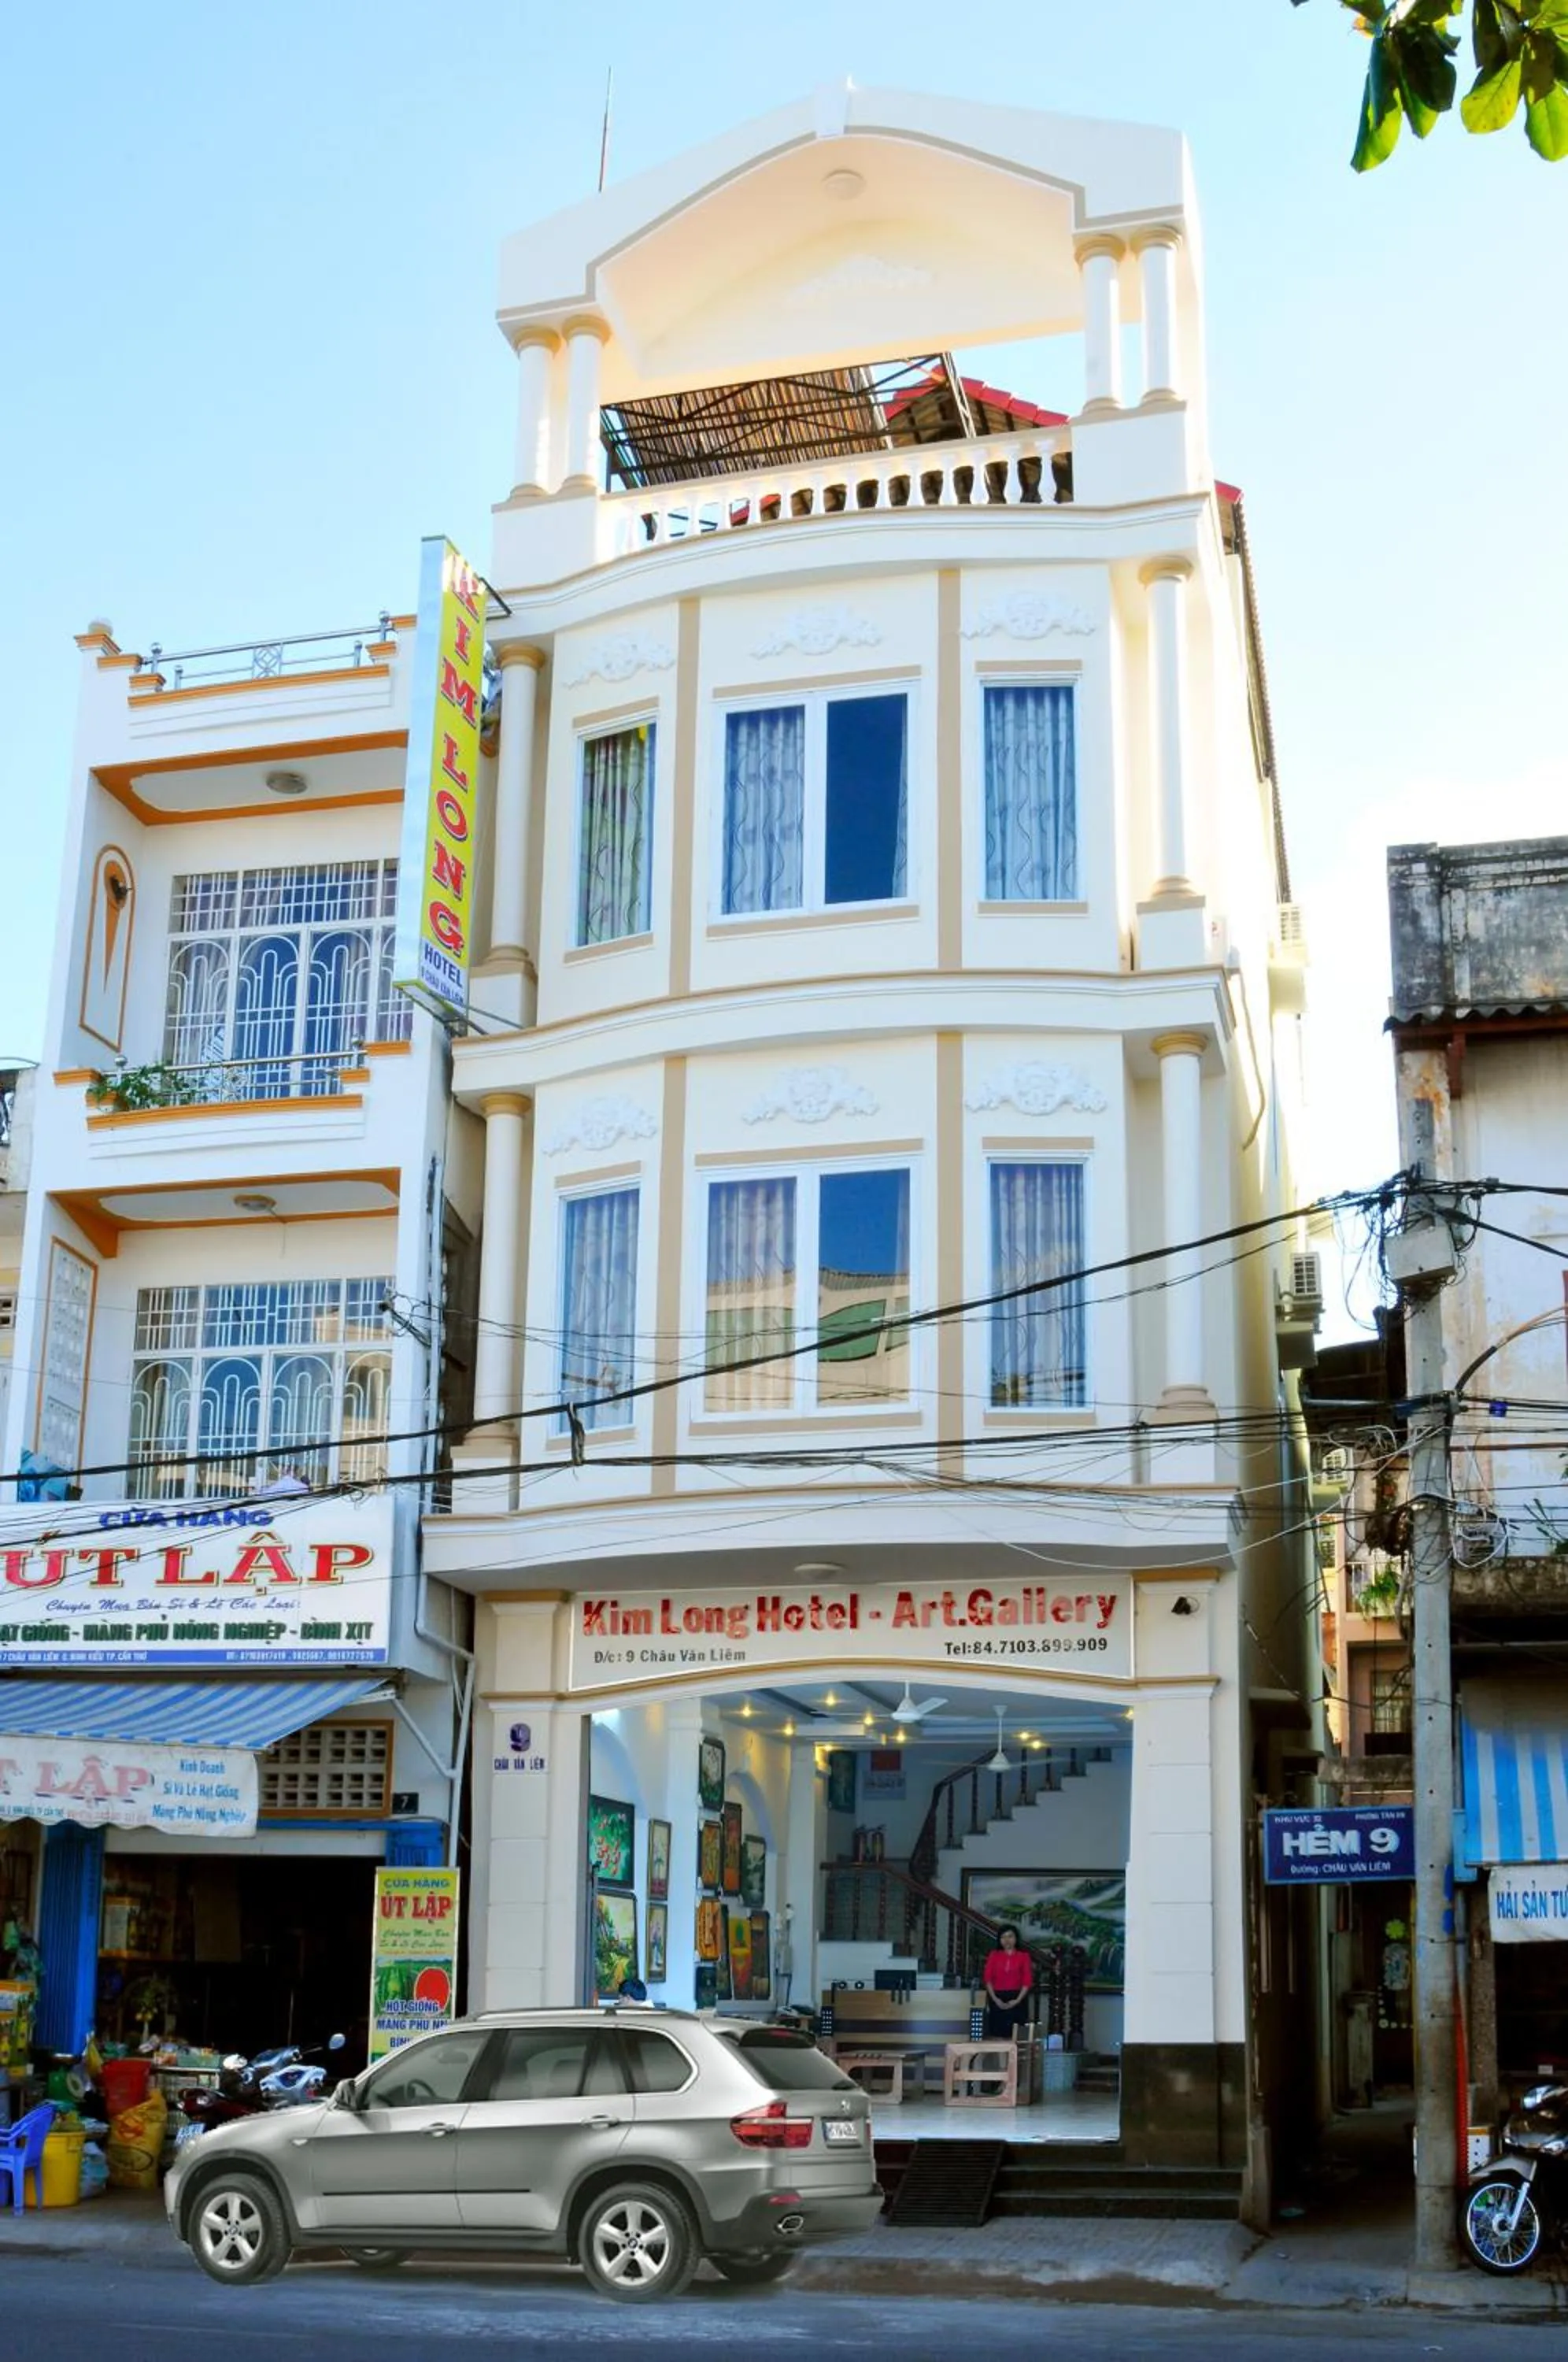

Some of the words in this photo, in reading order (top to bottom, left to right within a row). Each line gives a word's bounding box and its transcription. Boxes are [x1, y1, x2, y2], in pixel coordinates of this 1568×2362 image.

[440, 554, 482, 730] KIM
[429, 731, 469, 958] LONG
[424, 942, 463, 988] HOTEL
[155, 1531, 375, 1596] LẬP
[582, 1599, 653, 1636] Kim
[660, 1598, 749, 1640] Long
[756, 1593, 859, 1632] Hotel
[892, 1586, 1117, 1629] Art.Gallery
[626, 1649, 634, 1662] 9
[640, 1649, 675, 1662] Châu
[710, 1648, 745, 1661] Liêm
[35, 1755, 151, 1808] LẬP
[401, 1795, 409, 1809] 7
[1282, 1823, 1362, 1857] HẺM
[1369, 1827, 1400, 1853] 9
[381, 1890, 408, 1919] ÚT
[412, 1890, 453, 1923] LẬP
[1496, 1880, 1518, 1920] HẢI
[1522, 1879, 1548, 1920] SẢN
